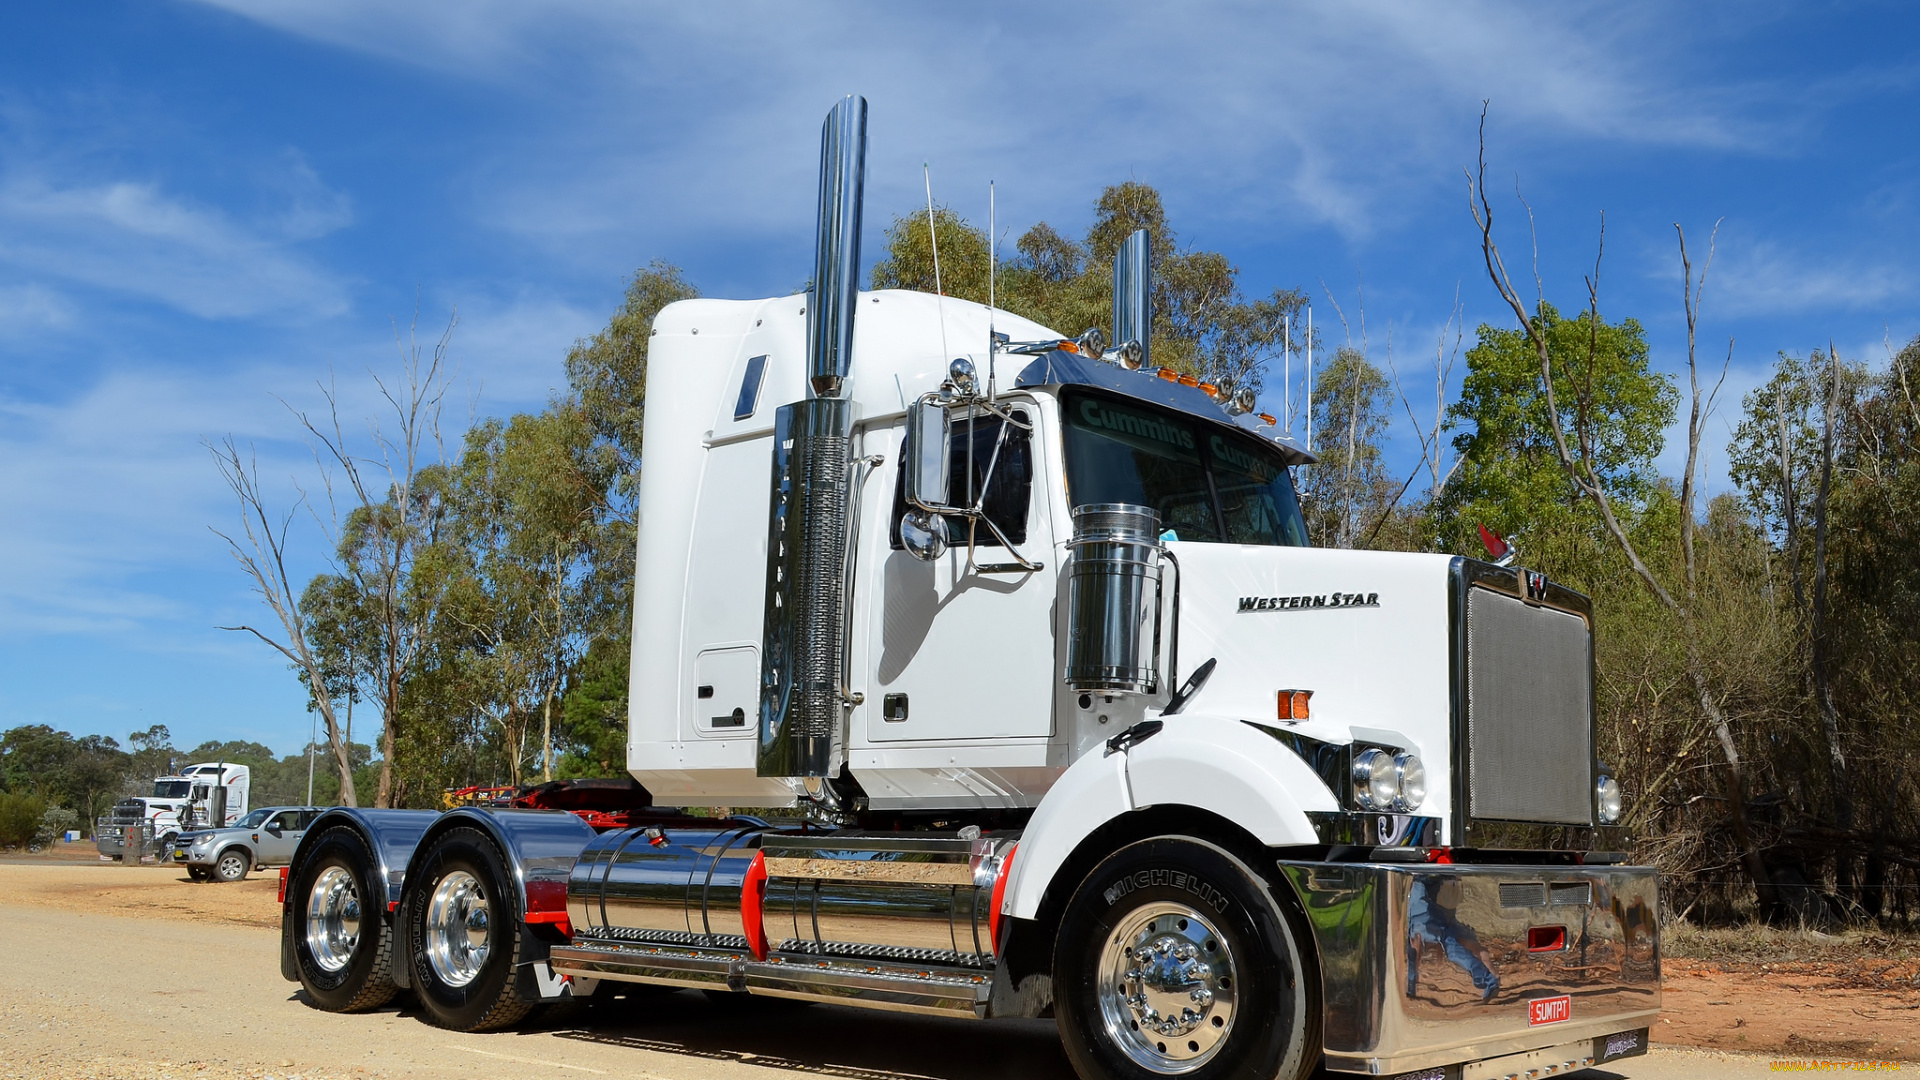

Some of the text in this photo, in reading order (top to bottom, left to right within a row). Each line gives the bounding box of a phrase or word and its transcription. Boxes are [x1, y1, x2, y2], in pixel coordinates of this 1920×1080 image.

[1081, 400, 1194, 449] Cummins
[1238, 592, 1380, 612] WESTERN STAR
[1103, 869, 1229, 914] MICHELIN
[413, 889, 432, 988] MICHELIN
